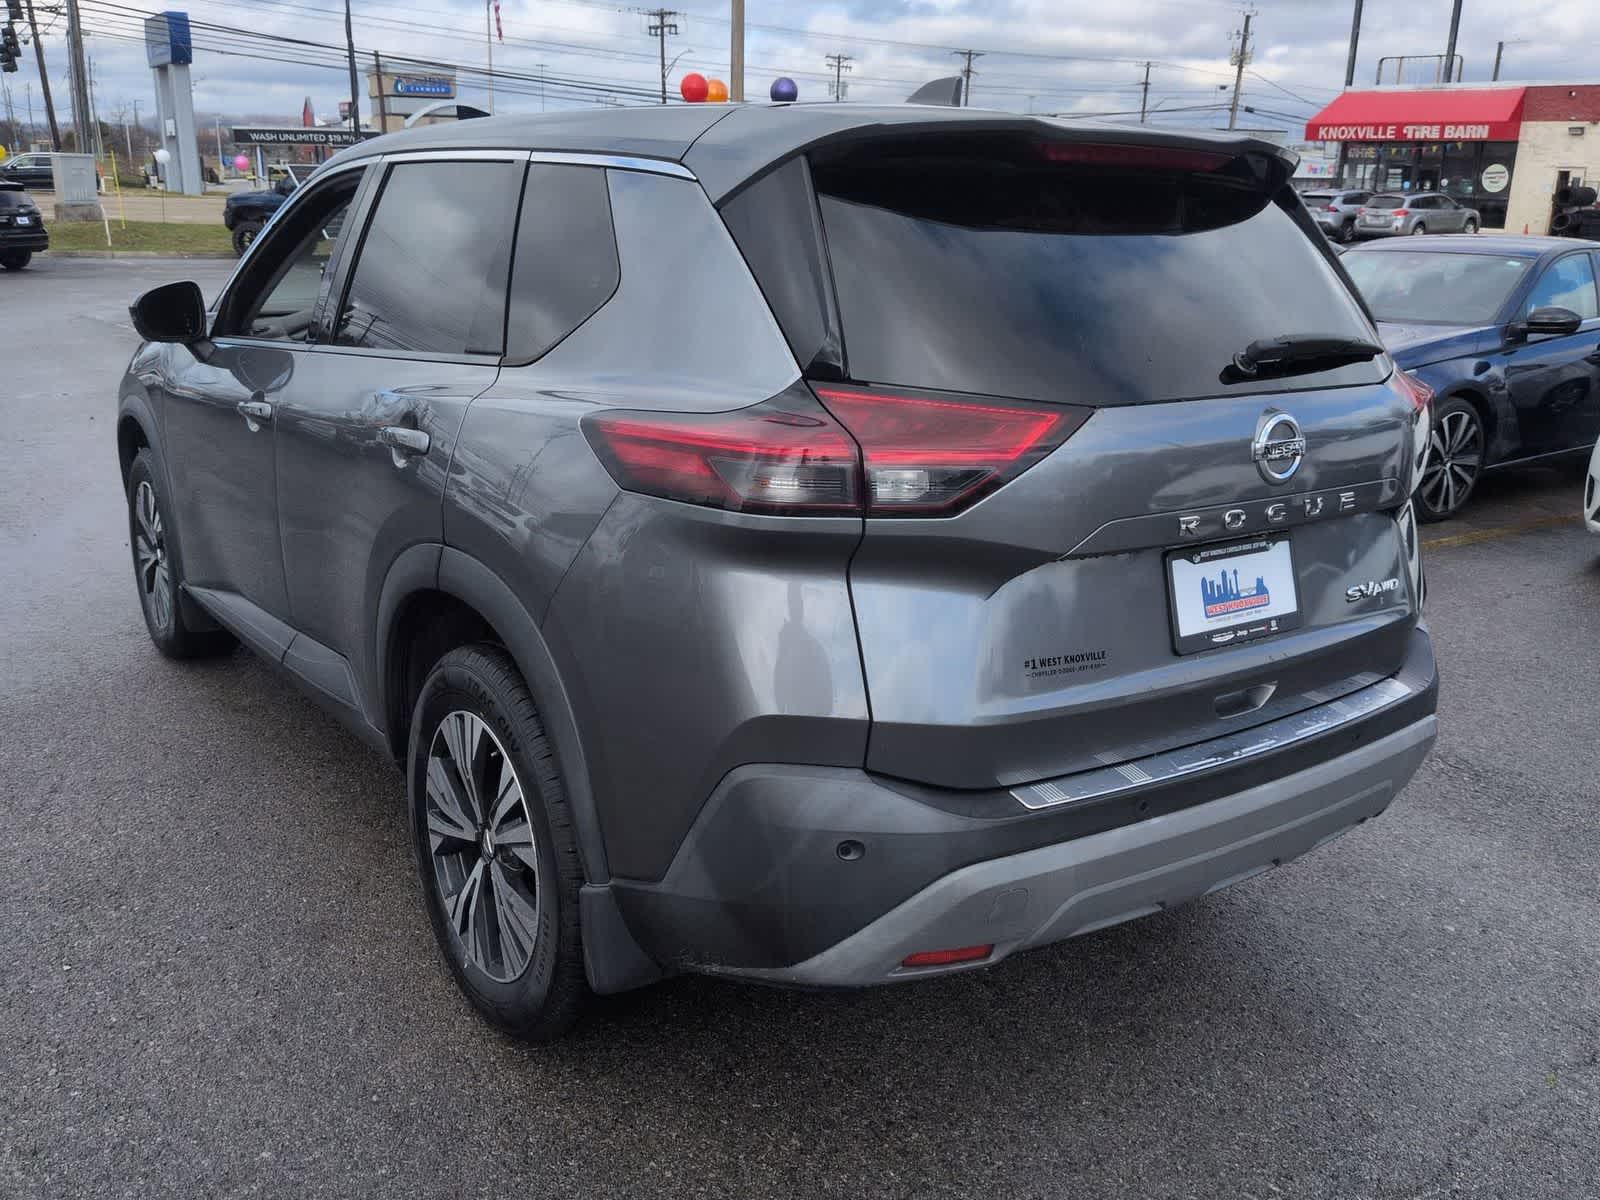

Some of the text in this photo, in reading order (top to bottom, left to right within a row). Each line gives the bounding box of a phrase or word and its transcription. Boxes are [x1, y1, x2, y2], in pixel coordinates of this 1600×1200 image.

[249, 133, 278, 143] WASH
[278, 133, 326, 143] UNLIMITED
[1318, 126, 1396, 140] KNOXVILLE
[1443, 125, 1490, 139] BARN
[1264, 441, 1304, 456] NISSAN
[1178, 491, 1356, 537] ROGUE
[1373, 577, 1400, 597] AWD
[1207, 594, 1269, 615] WEST KNOXVILLE
[1024, 650, 1106, 670] #1 WEST KNOXVILLE
